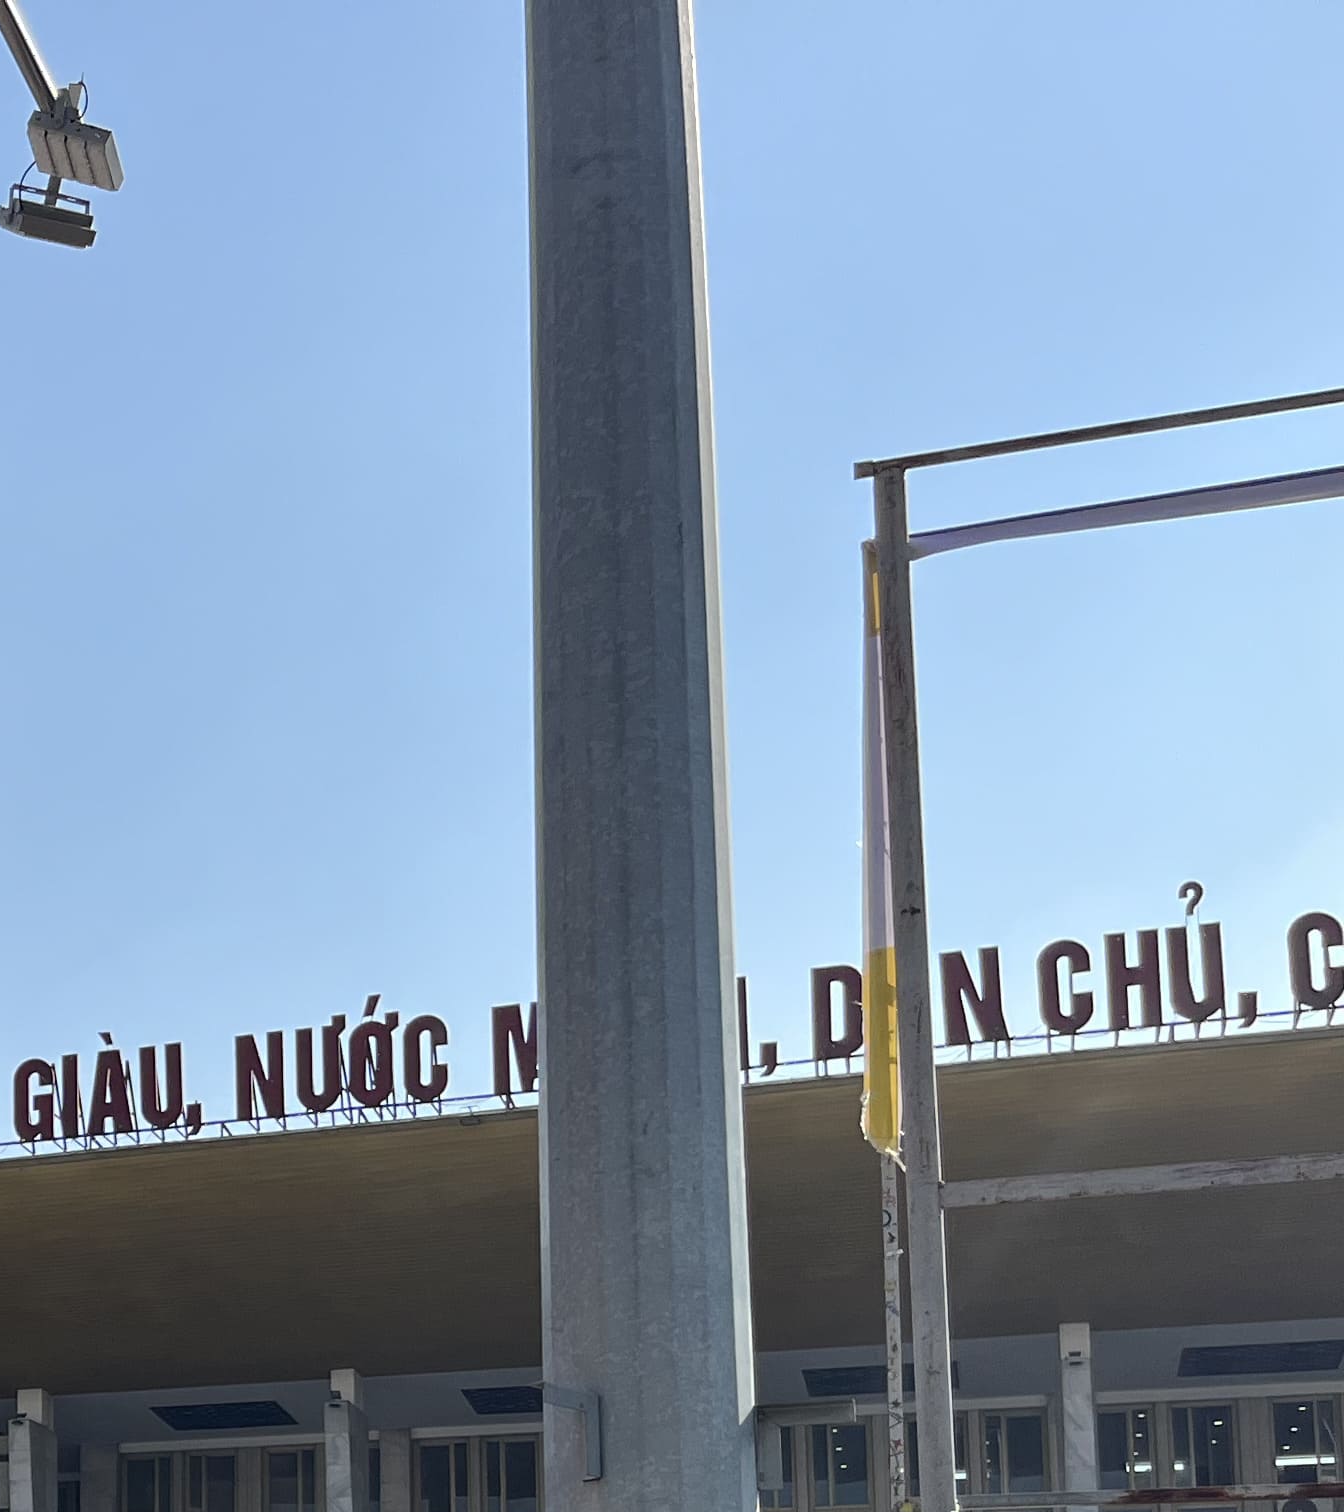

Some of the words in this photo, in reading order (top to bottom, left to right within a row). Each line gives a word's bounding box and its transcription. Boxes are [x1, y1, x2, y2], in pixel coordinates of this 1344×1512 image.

[12, 1032, 201, 1143] GIÀU,
[235, 994, 449, 1120] NƯỚC
[811, 945, 1010, 1060] DN
[1036, 880, 1258, 1032] CHỦ,
